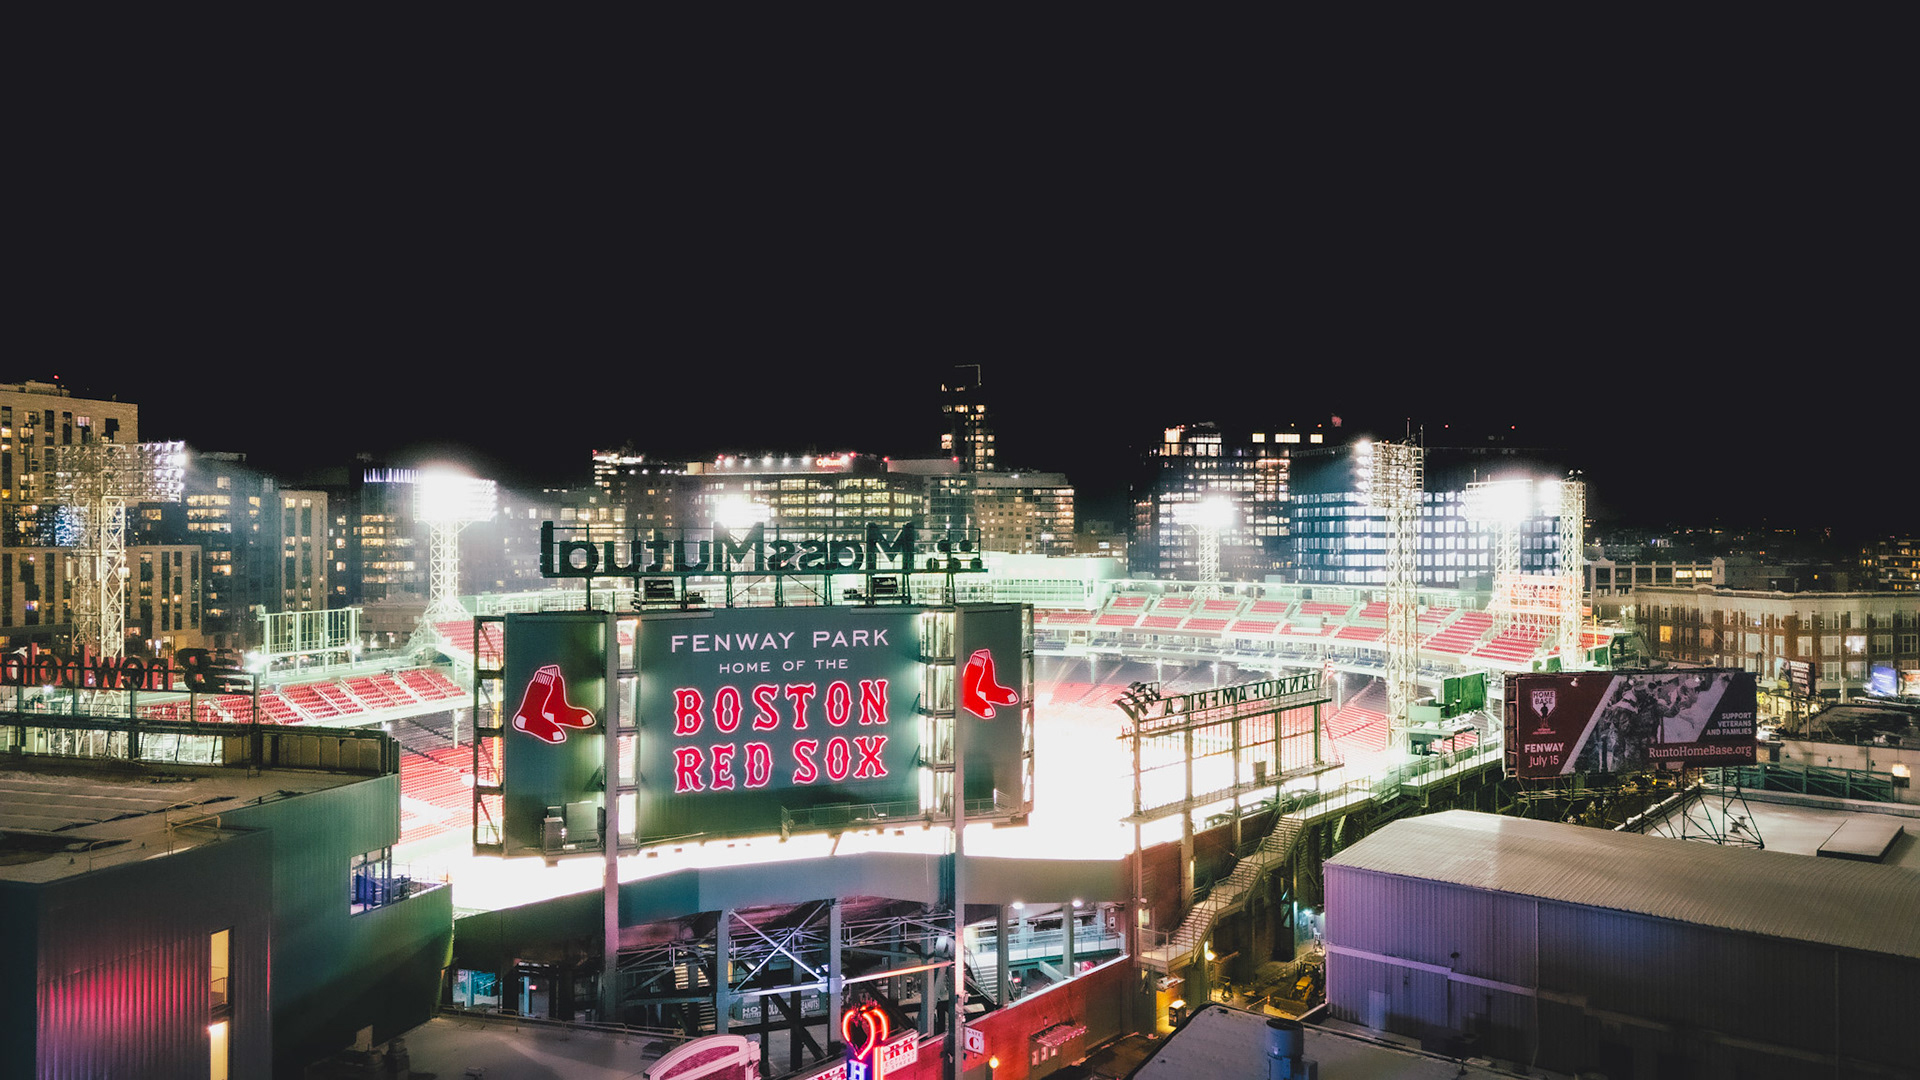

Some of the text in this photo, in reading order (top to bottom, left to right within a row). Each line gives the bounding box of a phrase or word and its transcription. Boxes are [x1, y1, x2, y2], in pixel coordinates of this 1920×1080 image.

[671, 629, 889, 653] FENWAY PARK
[719, 659, 849, 674] HOME OF THE
[1533, 691, 1554, 699] HOME
[672, 679, 889, 737] BOSTON
[1722, 712, 1752, 720] SUPPORT
[1718, 720, 1752, 728] VETERANS
[1722, 728, 1752, 736] FAMILIES
[1524, 742, 1564, 754] FENWAY
[1648, 744, 1752, 758] RuntoHomeBase.org
[672, 735, 889, 794] RED SOX
[1528, 755, 1560, 768] July 15
[742, 1006, 762, 1014] HO
[968, 1036, 980, 1050] C
